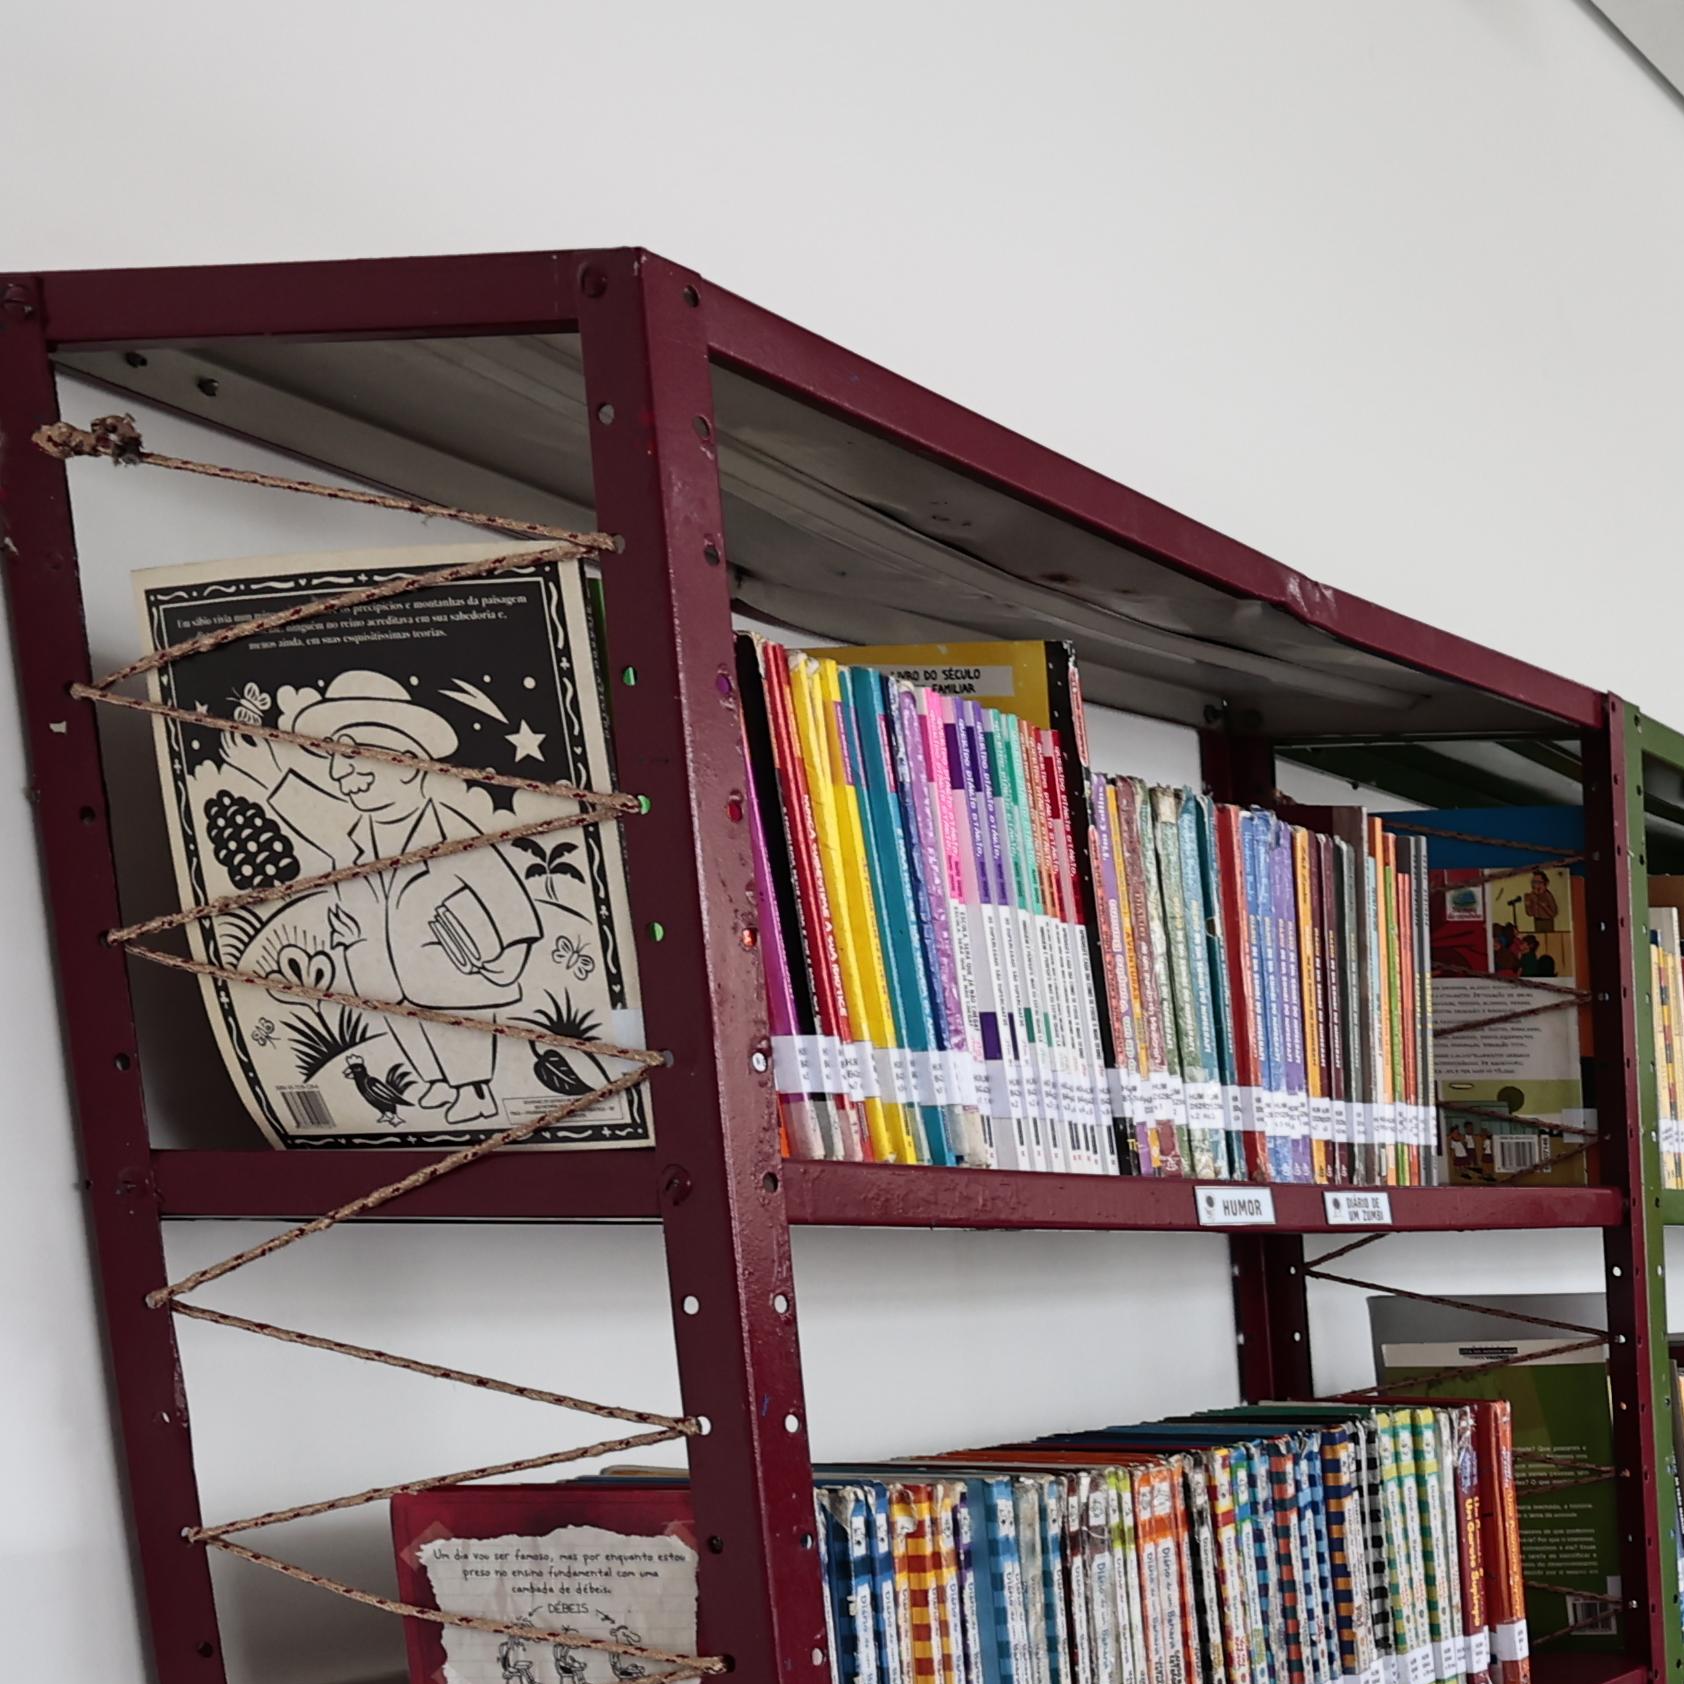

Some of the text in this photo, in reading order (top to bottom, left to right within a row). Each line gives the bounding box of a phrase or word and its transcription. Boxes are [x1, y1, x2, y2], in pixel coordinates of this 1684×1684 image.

[481, 594, 528, 607] paisagem
[924, 670, 937, 680] DO
[942, 667, 980, 680] SÉCULO
[932, 683, 976, 694] FAMILIAR
[1223, 1199, 1263, 1216] HUMOR
[1373, 1197, 1380, 1209] DE
[1350, 1210, 1384, 1222] UM ZUMBI
[433, 1548, 686, 1566] Um dia vou ser famoso, mas por enquanto estou
[462, 1565, 659, 1581] preso no ensino fundamental com uma
[511, 1582, 554, 1594] cambada
[559, 1582, 571, 1594] de
[548, 1600, 589, 1614] DÉBEIS
